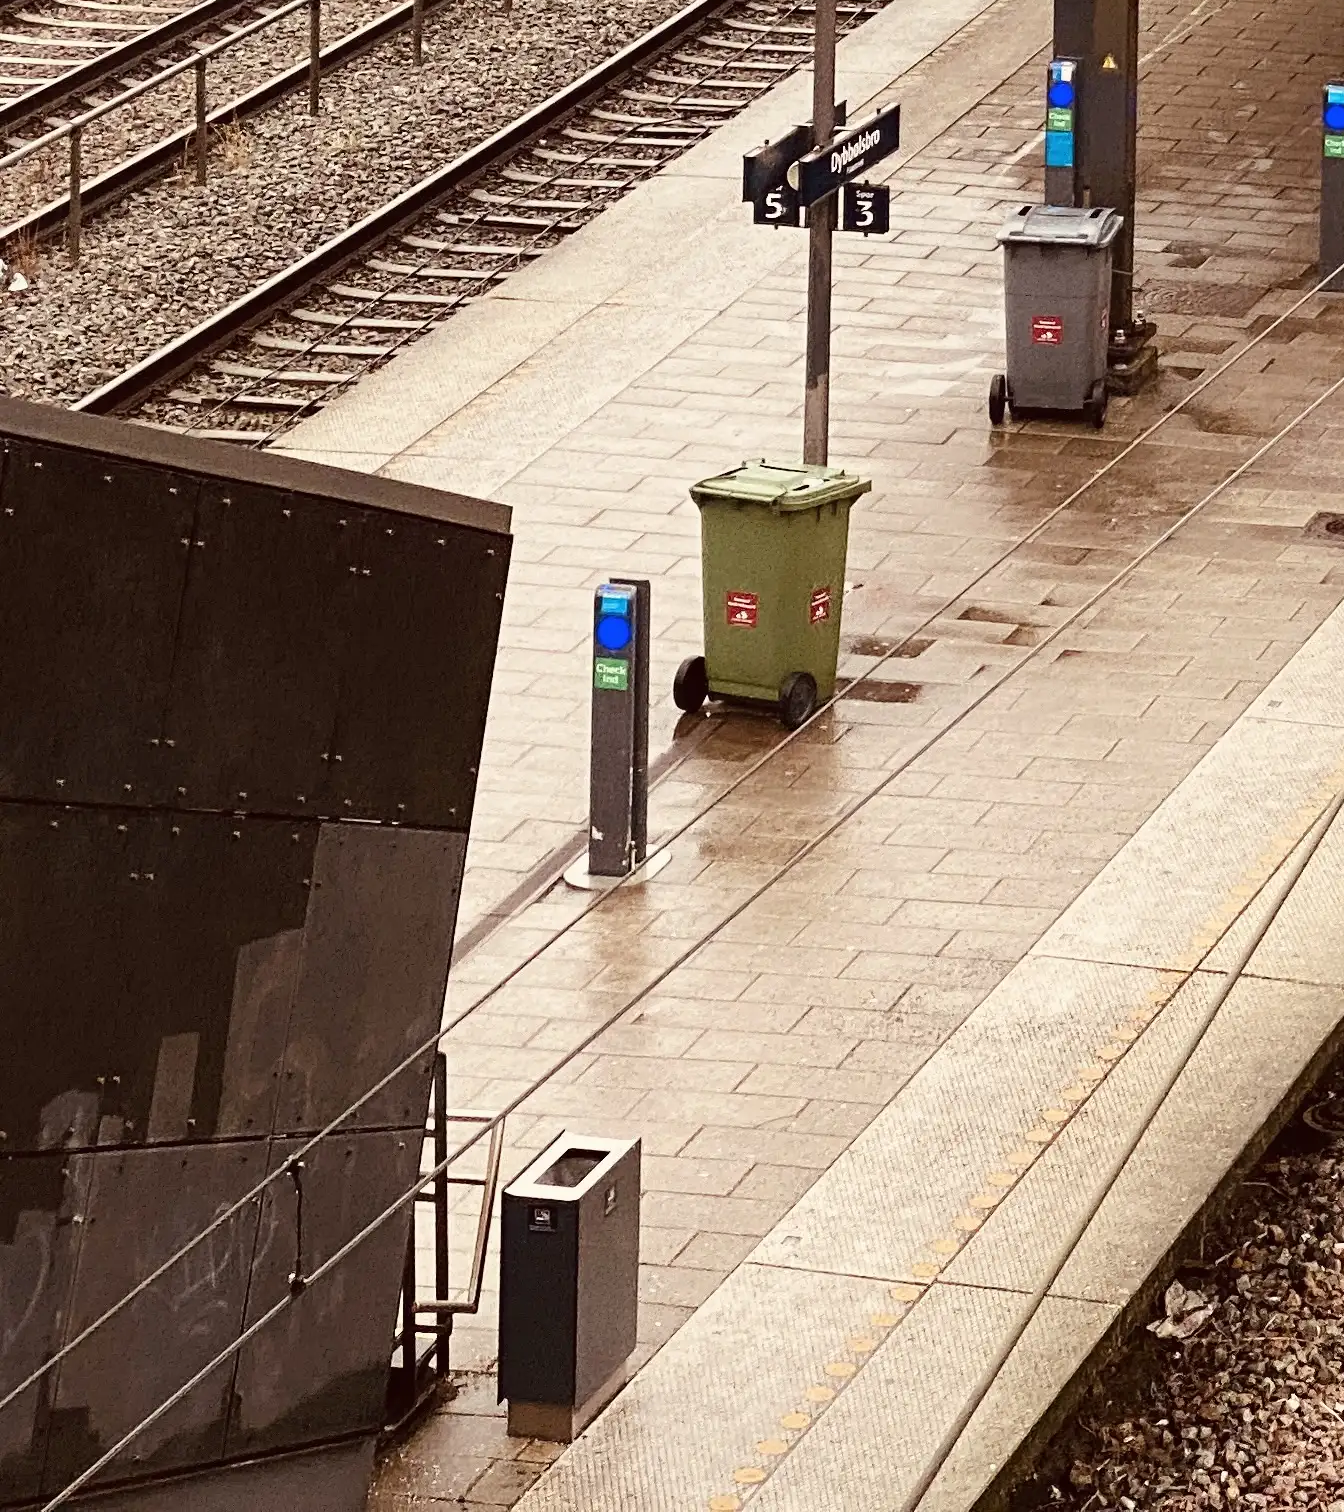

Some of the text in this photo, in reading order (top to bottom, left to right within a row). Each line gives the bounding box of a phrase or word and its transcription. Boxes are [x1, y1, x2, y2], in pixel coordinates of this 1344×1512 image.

[765, 193, 783, 219] 5
[855, 201, 874, 226] 3
[596, 663, 626, 676] Check
